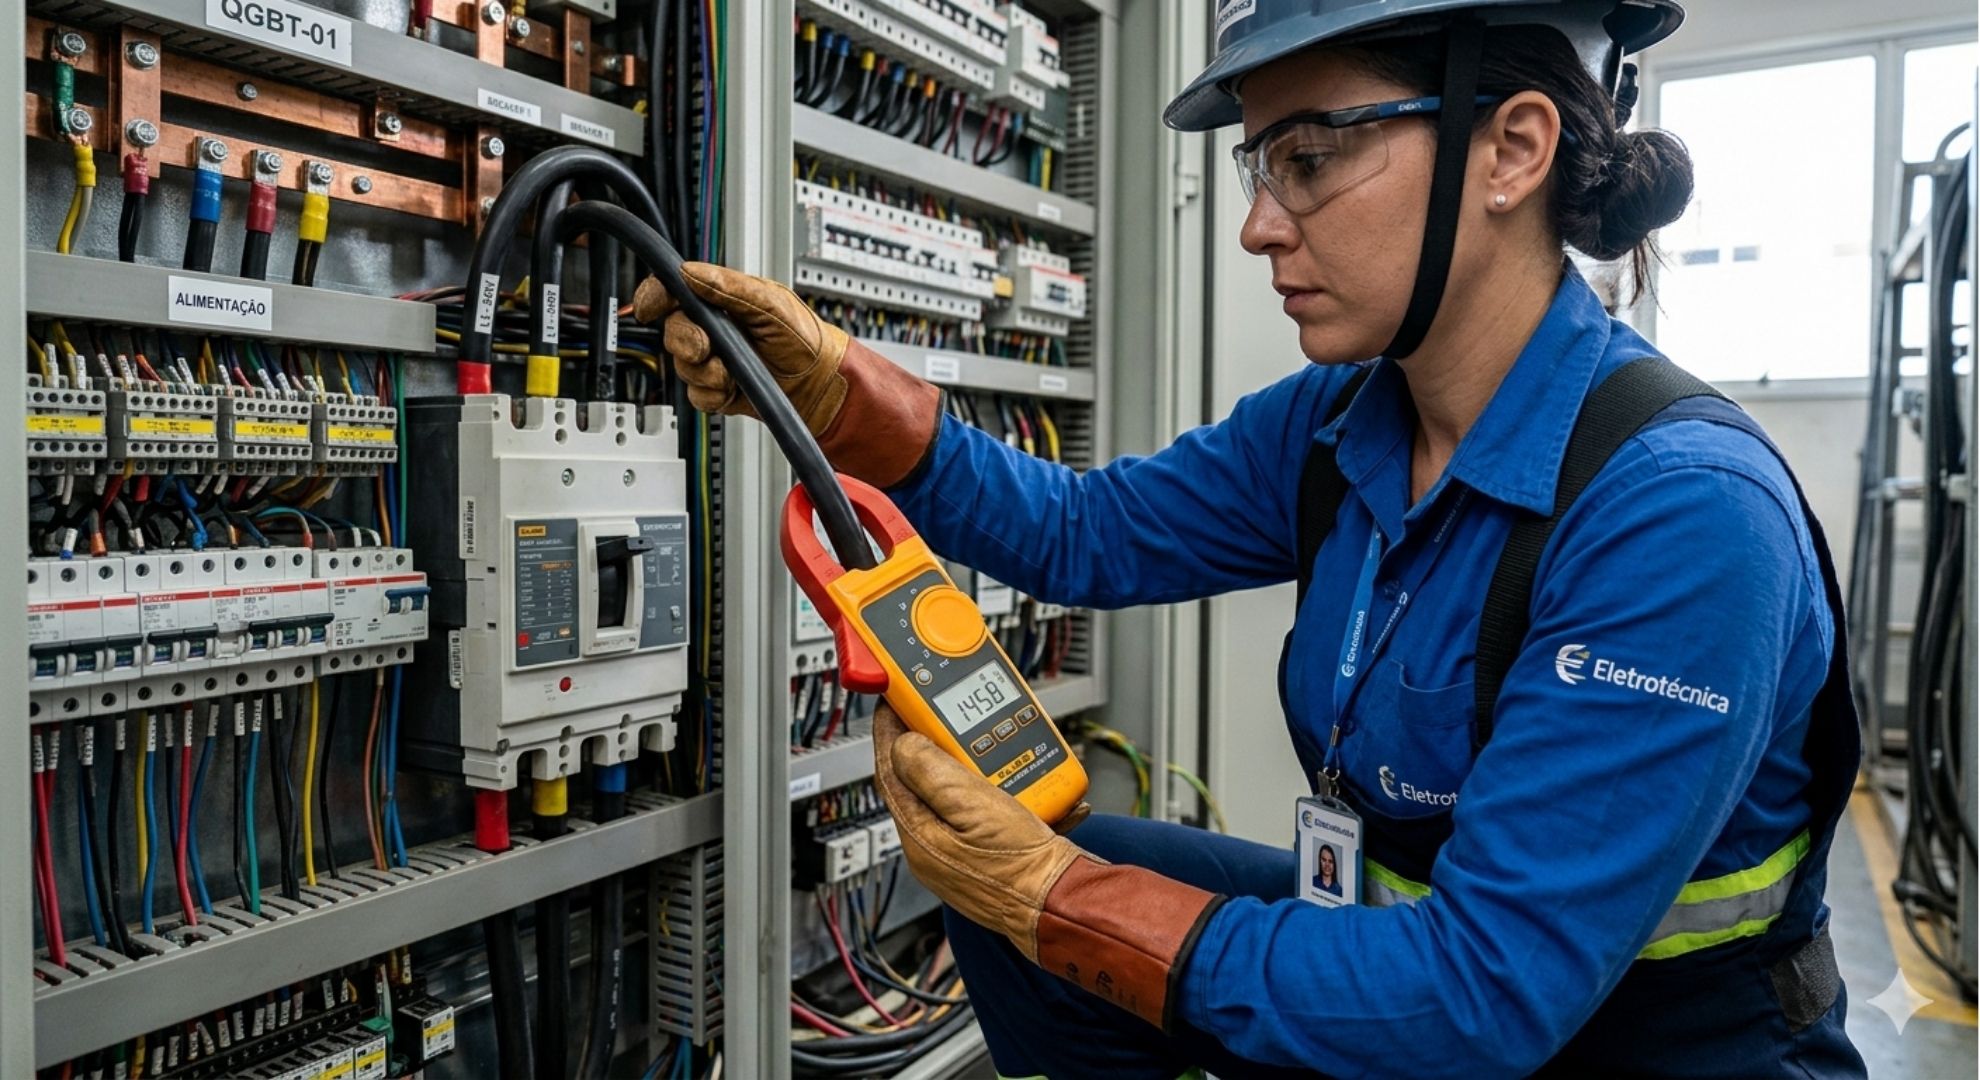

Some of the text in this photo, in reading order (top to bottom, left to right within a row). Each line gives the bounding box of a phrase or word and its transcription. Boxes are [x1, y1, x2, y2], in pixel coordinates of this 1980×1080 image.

[221, 0, 336, 49] QGBT-01
[175, 292, 266, 316] ALIMENTAÇÃO
[1593, 658, 1731, 714] Eletrotécnica
